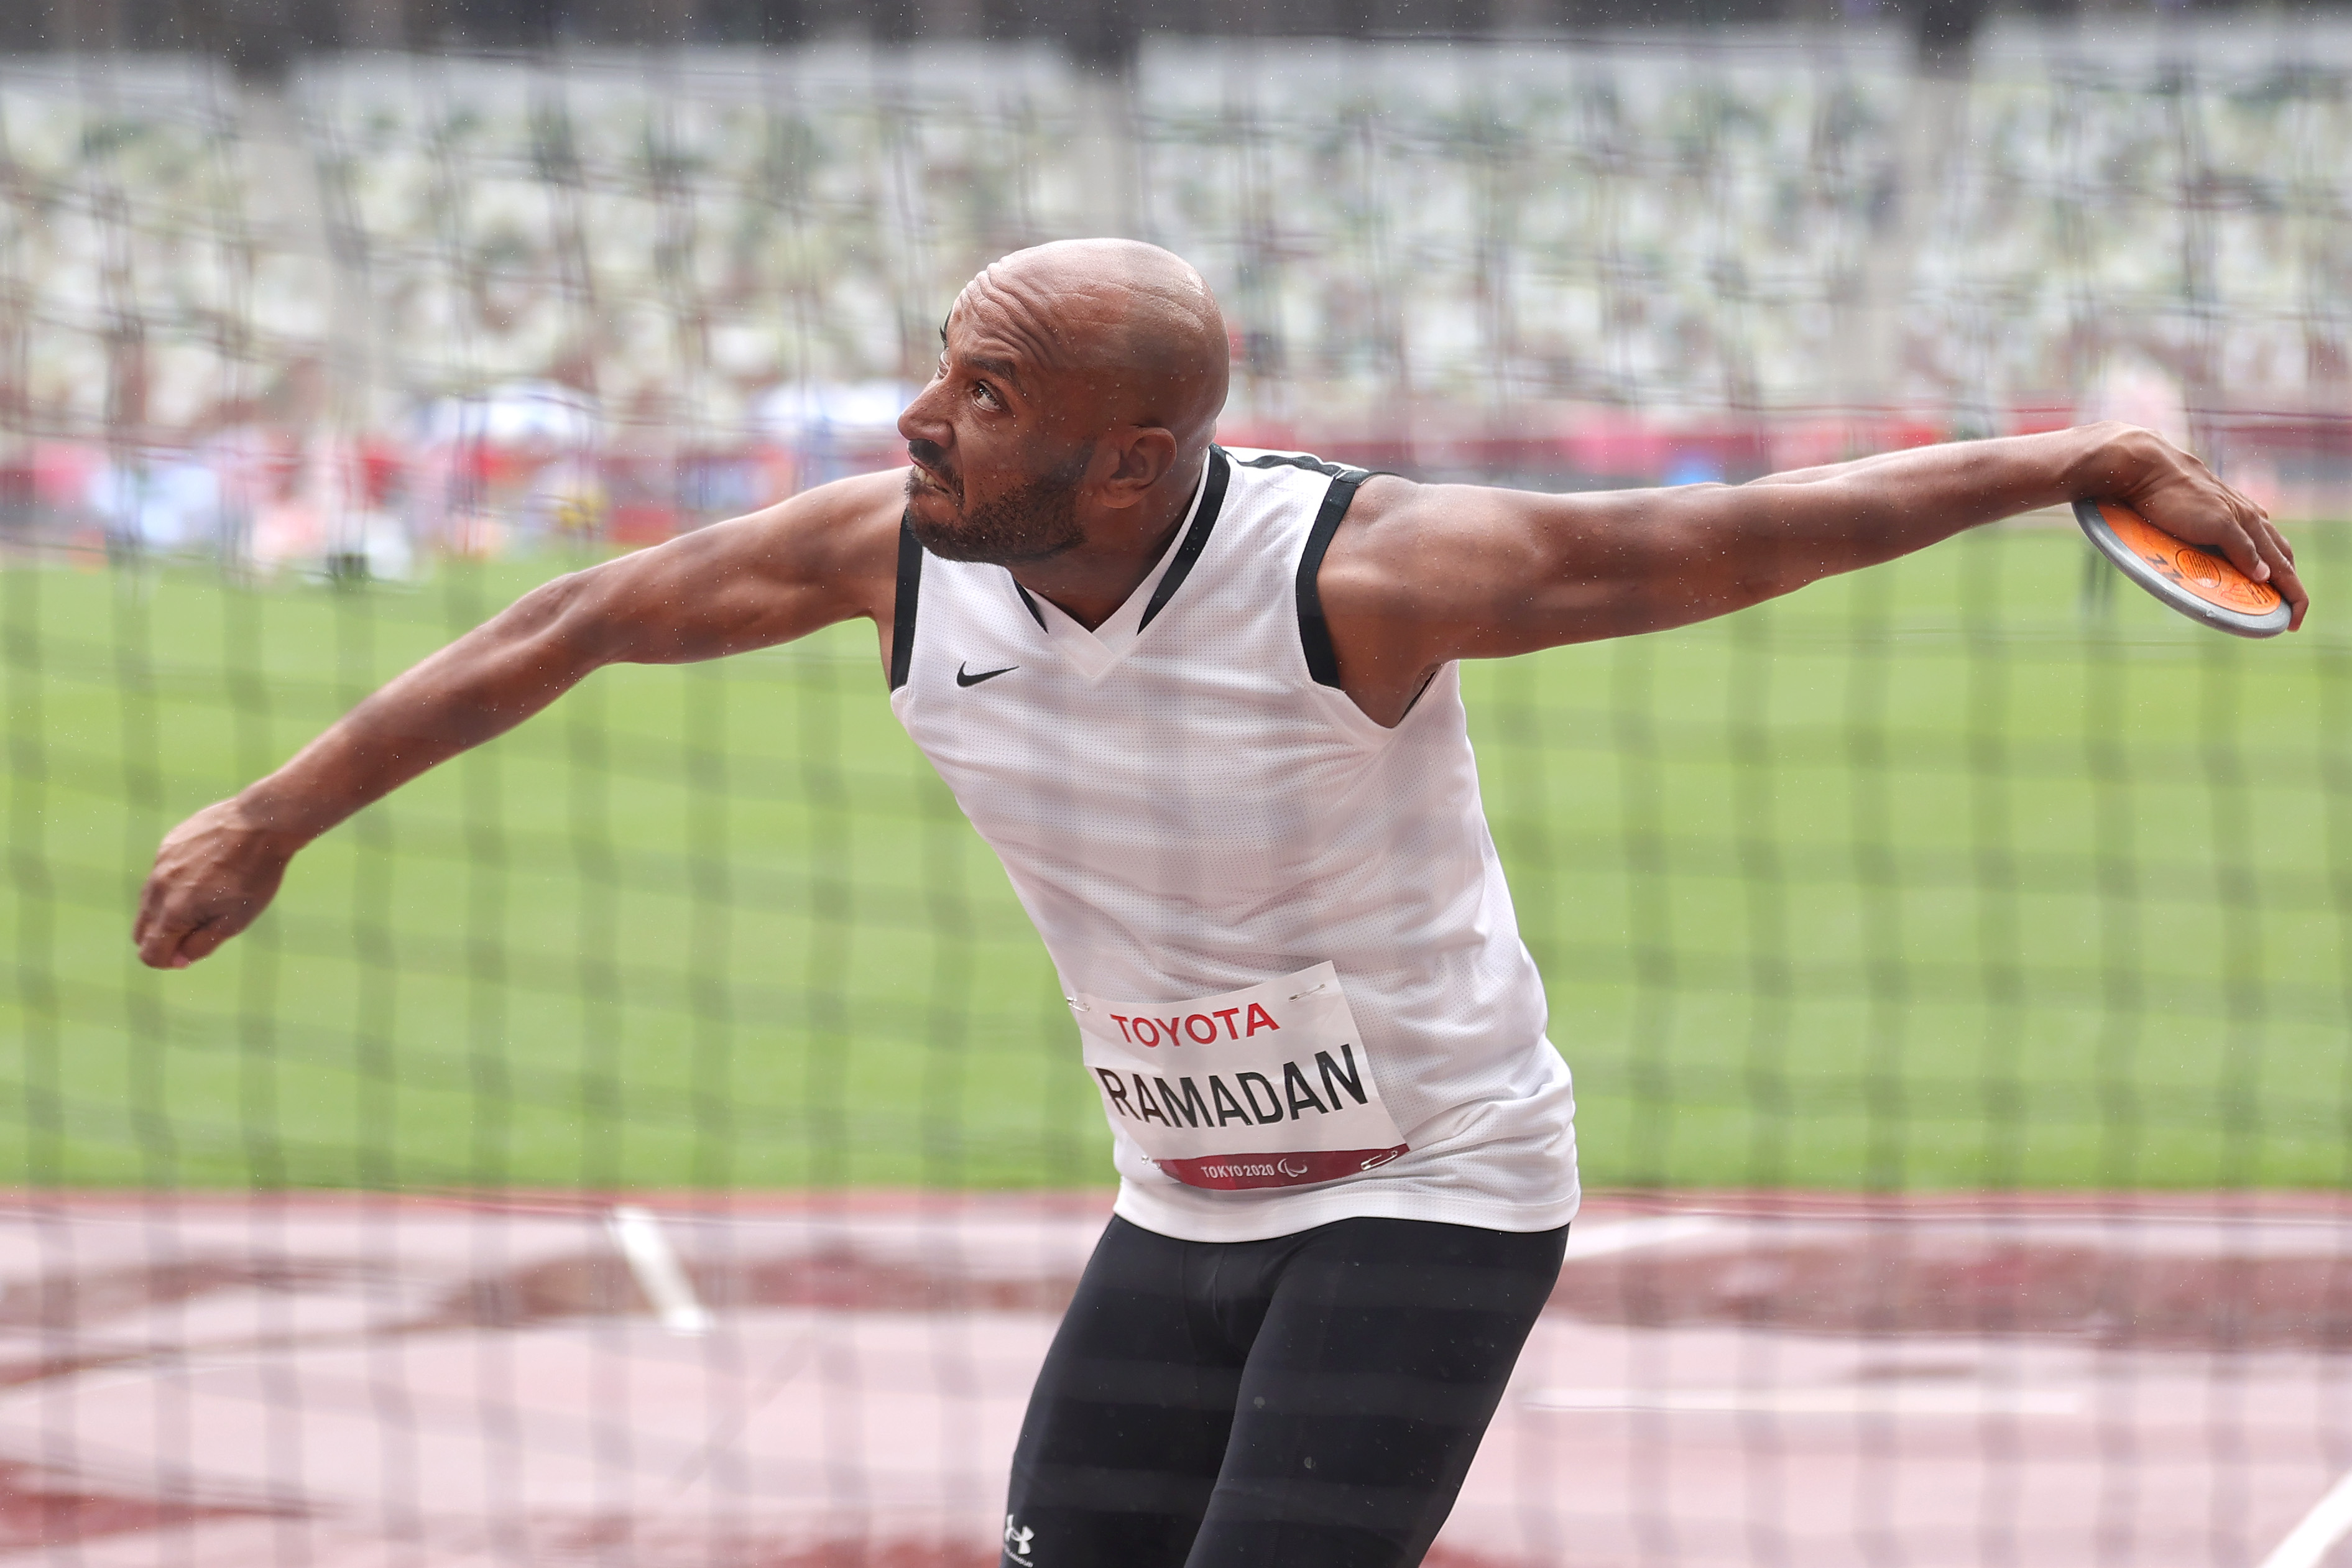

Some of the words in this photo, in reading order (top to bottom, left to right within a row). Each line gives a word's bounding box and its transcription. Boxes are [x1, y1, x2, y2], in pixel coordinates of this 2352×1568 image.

[1110, 1003, 1280, 1048] TOYOTA
[1095, 1044, 1368, 1128] RAMADAN
[1201, 1165, 1243, 1178] TOKYO
[1243, 1164, 1273, 1176] 2020
